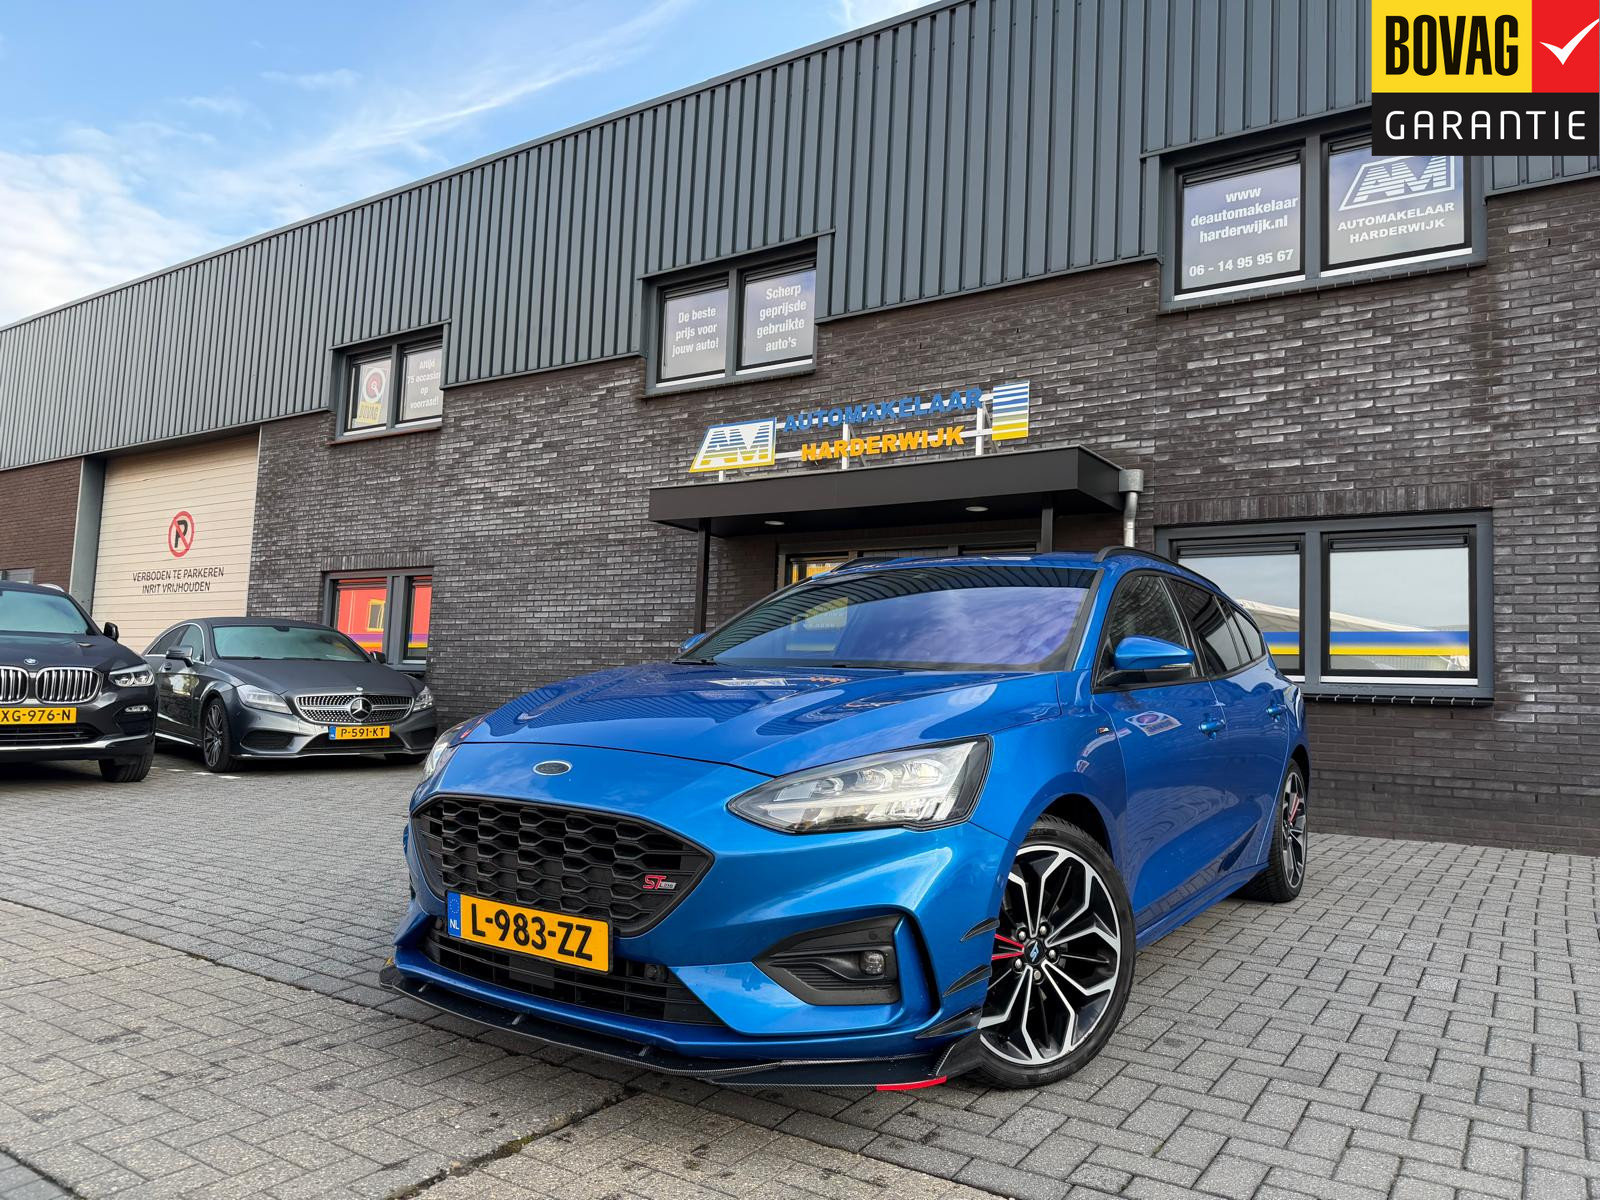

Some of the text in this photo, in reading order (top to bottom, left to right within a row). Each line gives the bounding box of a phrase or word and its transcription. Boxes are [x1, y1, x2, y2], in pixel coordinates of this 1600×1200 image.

[1225, 185, 1262, 203] www
[1190, 197, 1299, 228] deautomakelaar
[1337, 202, 1455, 231] AUTOMAKELAAR
[1199, 215, 1289, 243] harderwijk.nl
[1349, 218, 1446, 244] HARDERWIJK
[1189, 263, 1206, 277] 06
[1217, 259, 1235, 274] 14
[1236, 255, 1254, 271] 95
[1256, 252, 1275, 268] 95
[1277, 248, 1295, 264] 67
[766, 284, 802, 300] Scherp
[678, 306, 717, 324] De beste
[759, 300, 807, 321] geprijsde
[675, 323, 718, 342] prijs voor
[756, 317, 805, 339] gebruikte
[671, 338, 719, 358] jouw auto!
[765, 337, 797, 352] auto's
[783, 386, 984, 433] AUTOMAKELAAR
[801, 425, 965, 462] HARDERWIJK
[132, 566, 224, 582] VERBODEN TE PARKEREN
[142, 581, 211, 594] INRIT VRIJHOUDEN
[1, 709, 71, 722] XG-976-N
[341, 727, 385, 737] P-591-KT
[643, 874, 667, 889] ST
[449, 919, 460, 930] NL
[471, 903, 593, 962] L-983-ZZ
